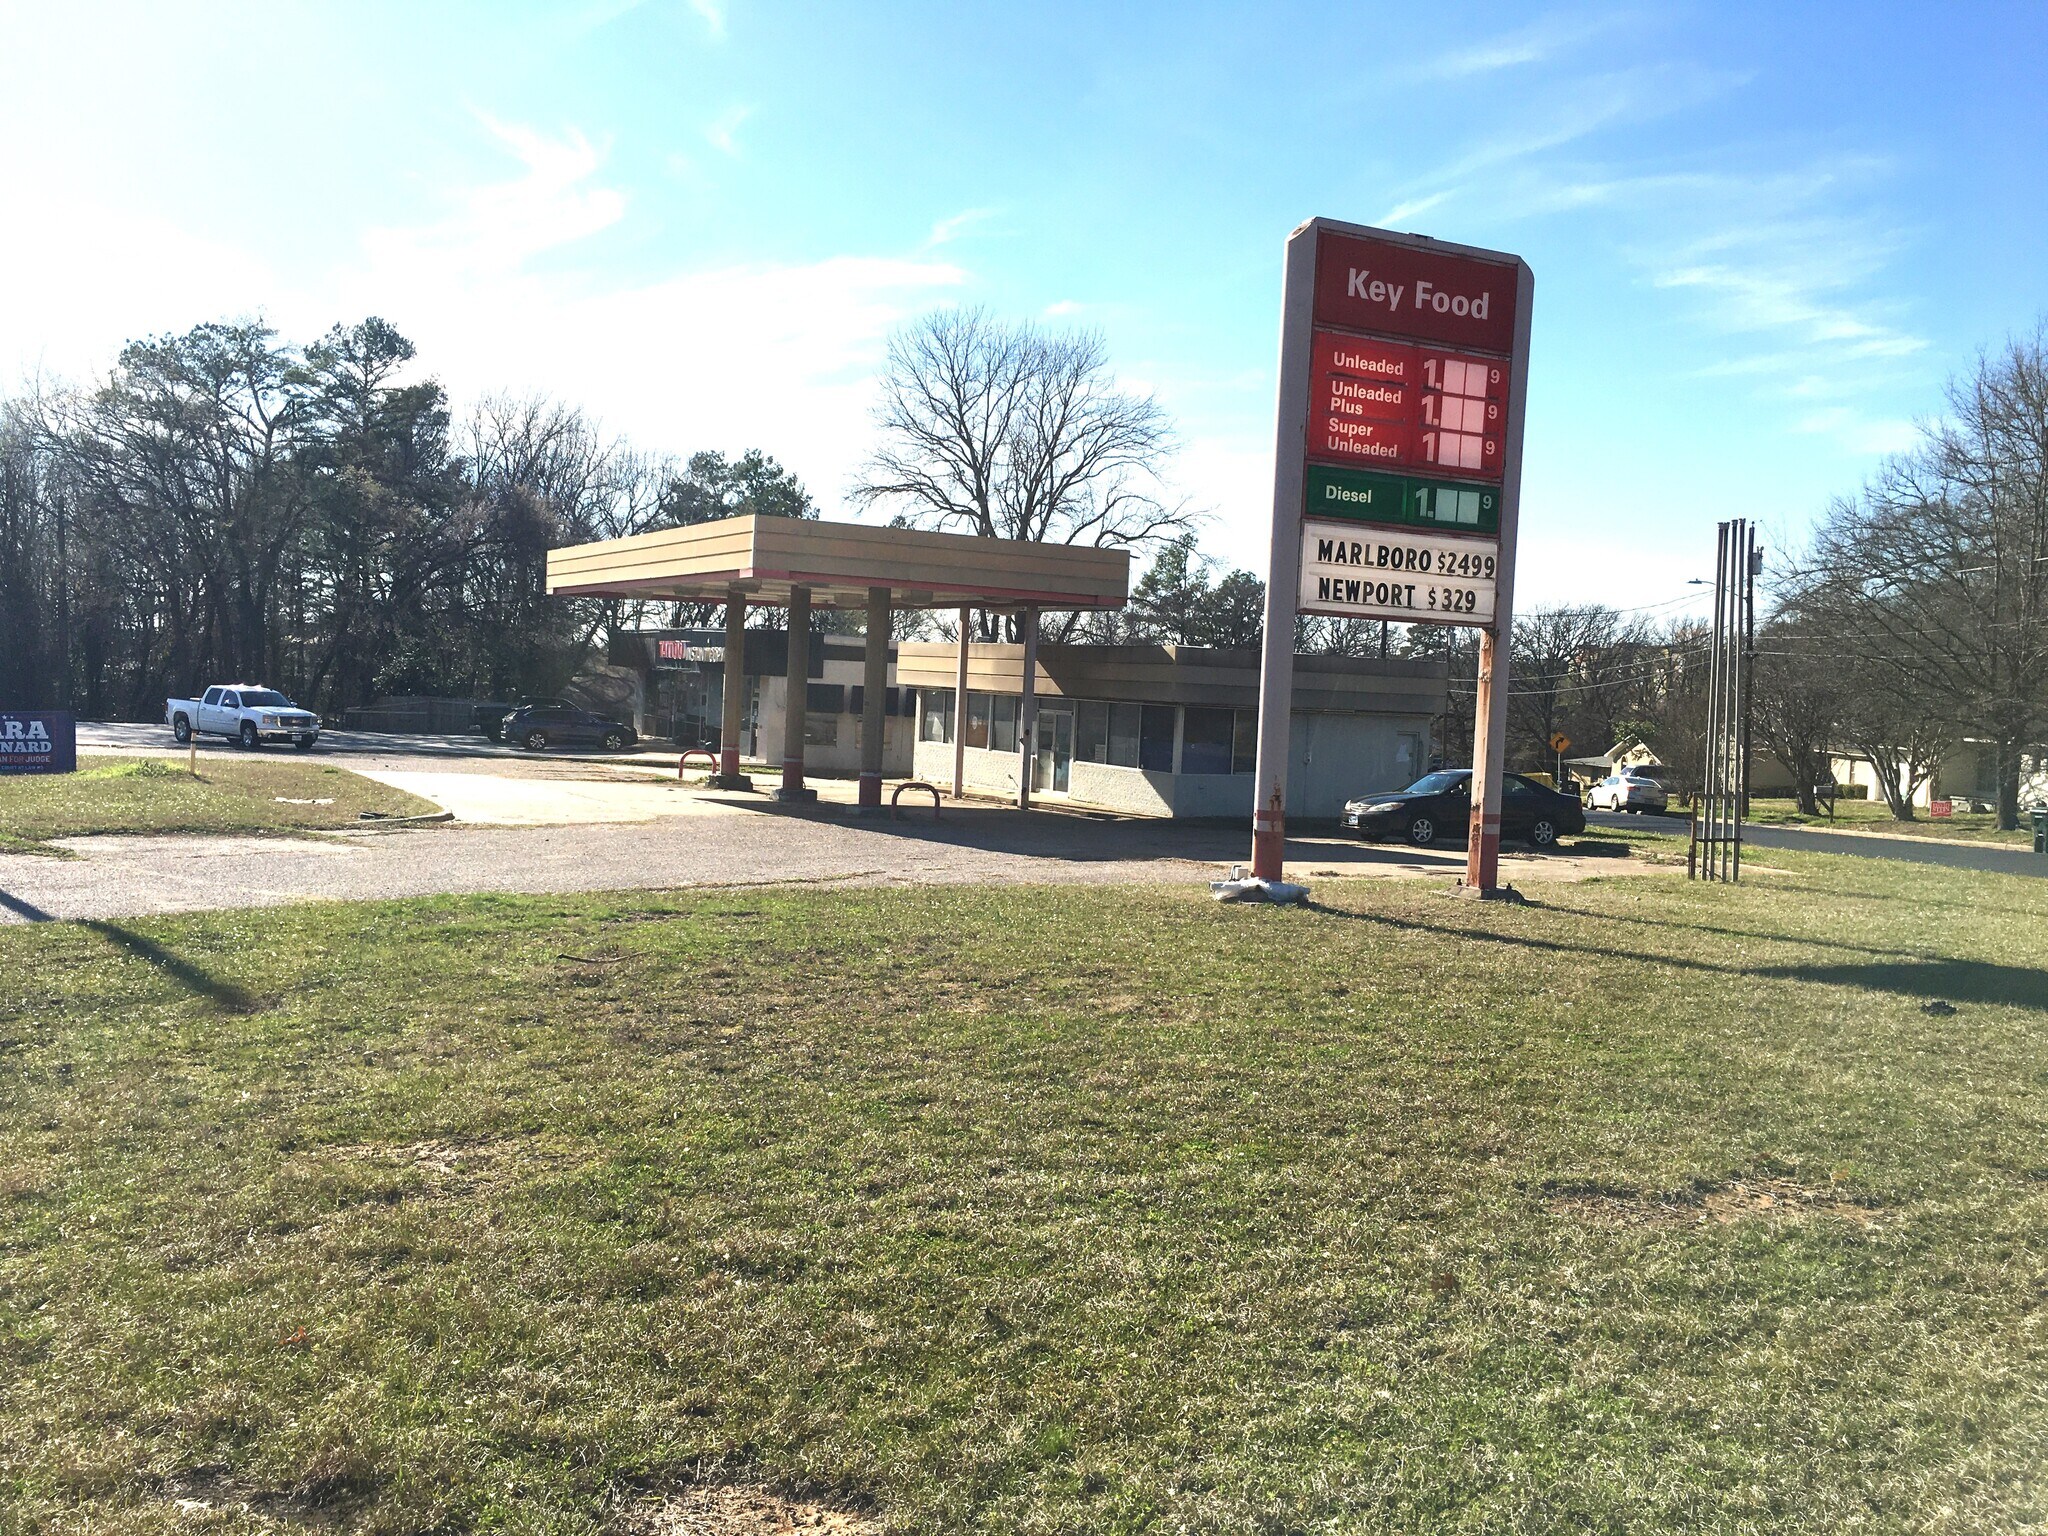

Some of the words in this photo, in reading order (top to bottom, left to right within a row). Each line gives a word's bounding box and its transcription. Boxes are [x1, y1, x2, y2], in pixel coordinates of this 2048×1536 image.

[1347, 267, 1405, 312] Key
[1415, 280, 1490, 320] Food
[1333, 351, 1404, 376] Unleaded
[1490, 369, 1500, 384] 9
[1332, 380, 1402, 404] Unleaded
[1330, 397, 1363, 415] Plus
[1487, 405, 1498, 420] 9
[1328, 417, 1373, 437] Super
[1327, 435, 1398, 458] Unleaded
[1485, 440, 1496, 455] 9
[1325, 485, 1372, 504] Diesel
[1482, 495, 1492, 510] 9
[1317, 539, 1432, 571] MARLBORO
[1437, 551, 1495, 578] $2499
[1318, 577, 1416, 607] NEWPORT
[0, 720, 49, 740] RA
[25, 755, 51, 763] JUDGE
